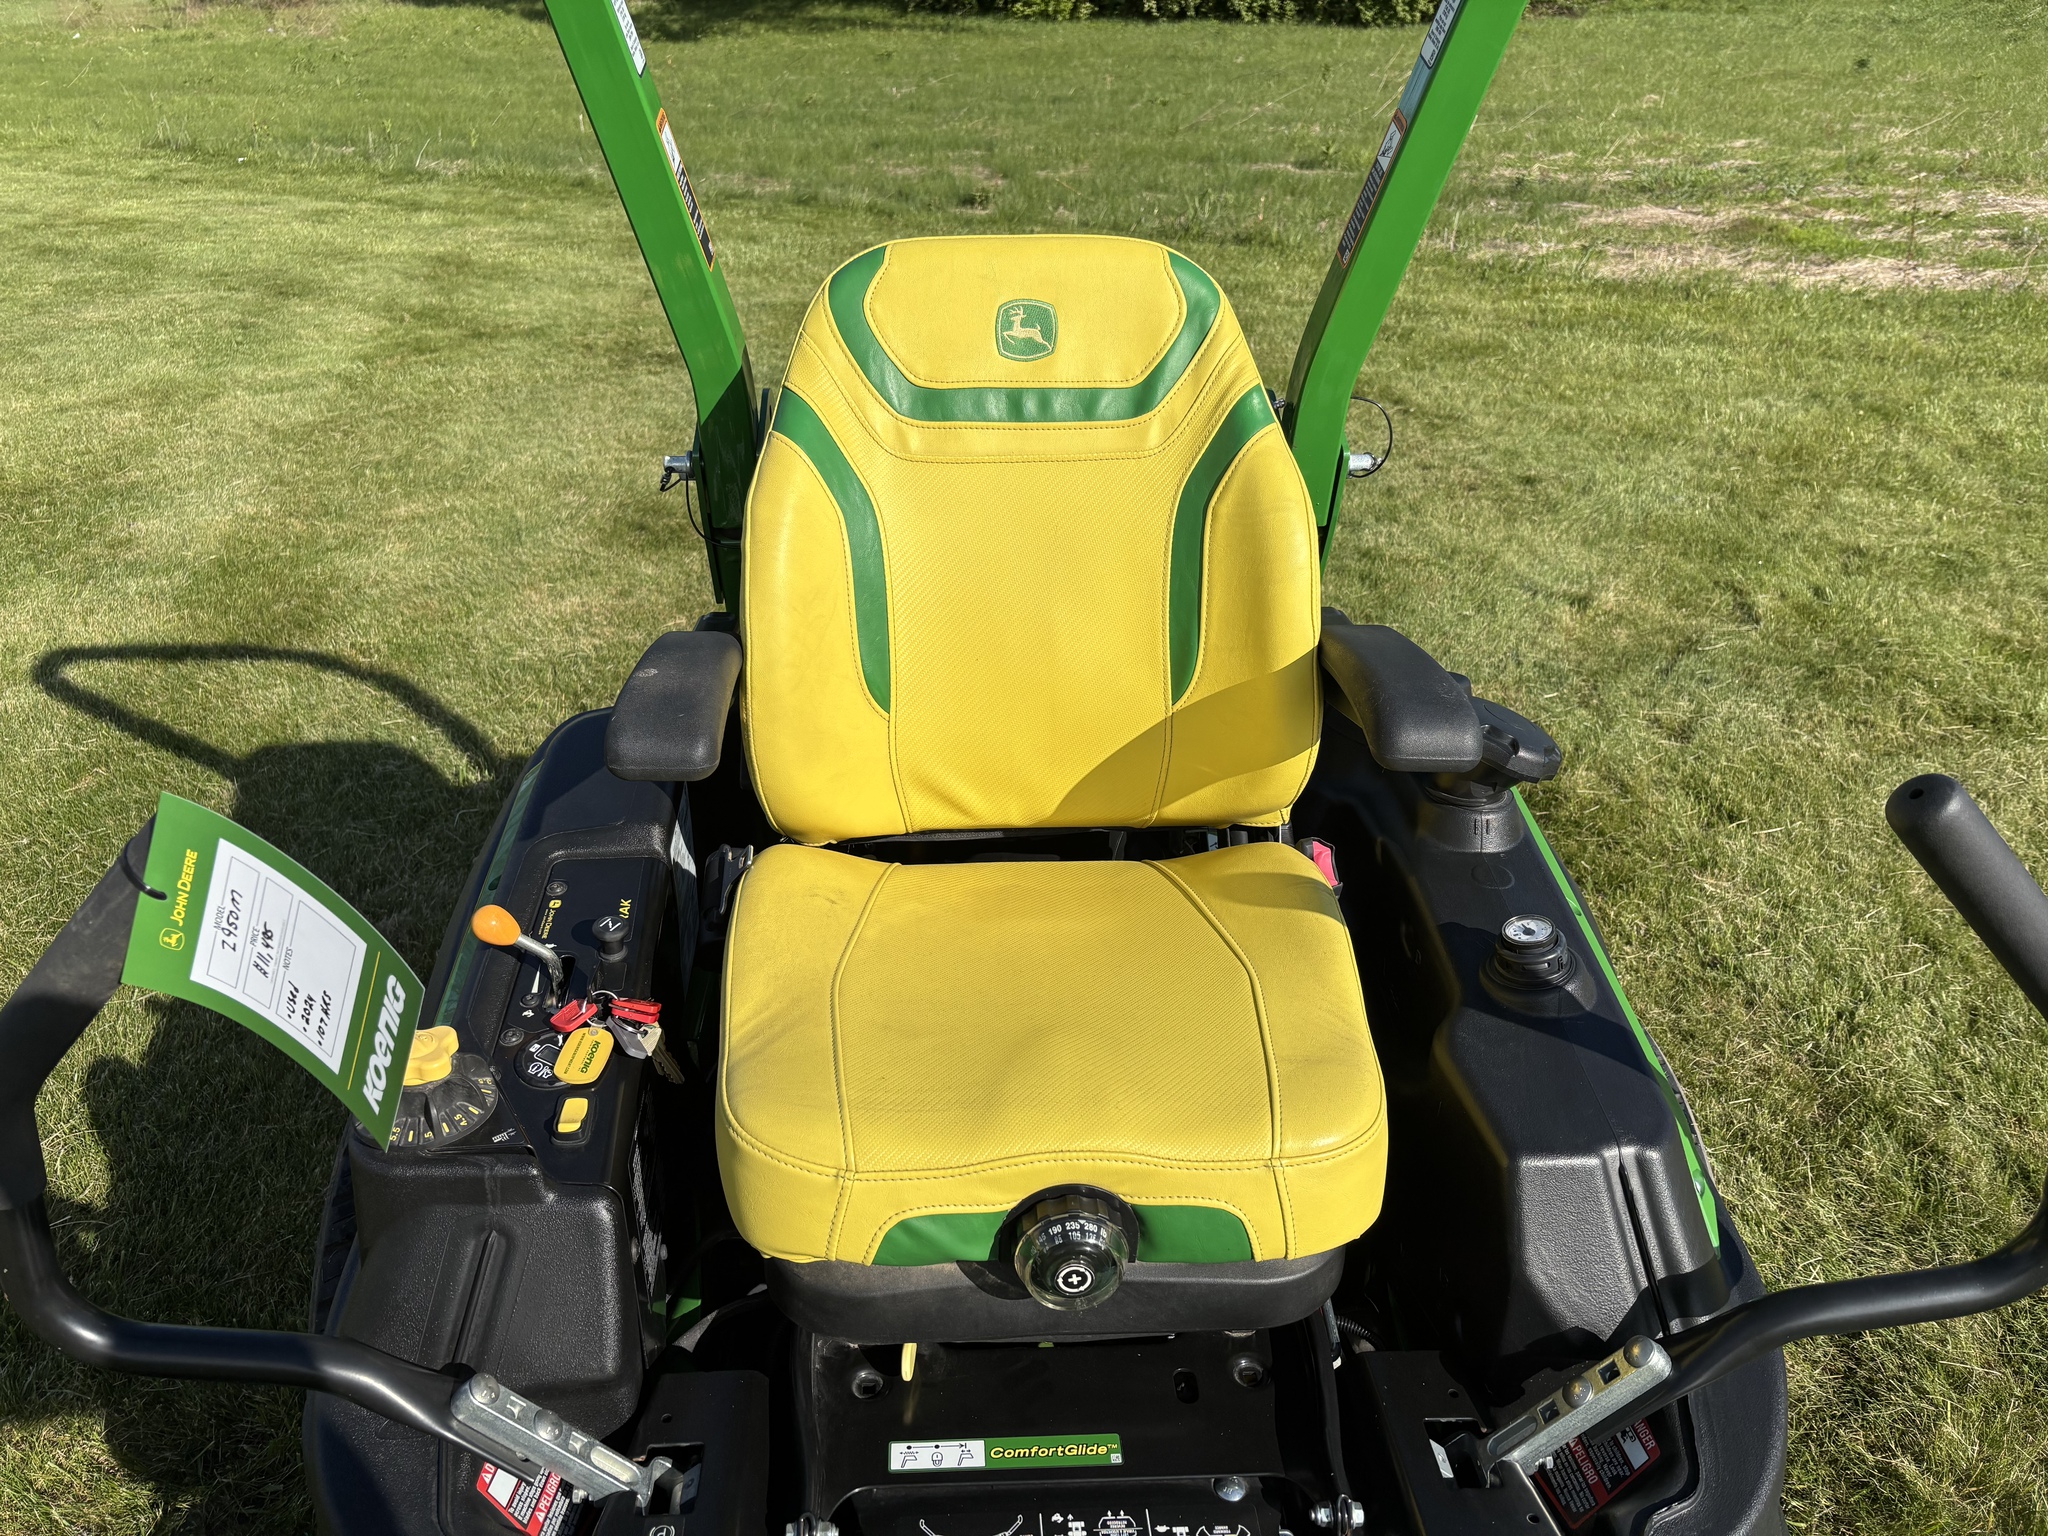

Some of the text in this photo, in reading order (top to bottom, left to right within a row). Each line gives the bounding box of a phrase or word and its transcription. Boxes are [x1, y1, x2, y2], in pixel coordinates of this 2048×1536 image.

[170, 848, 198, 926] JOHN DEERE
[213, 905, 226, 931] MODEL
[250, 926, 260, 948] PRICE
[282, 946, 294, 971] NOTES
[300, 994, 316, 1026] 2024
[316, 1016, 328, 1040] 107
[454, 1114, 468, 1126] 4.5
[390, 1127, 400, 1142] 5.5
[1048, 1224, 1062, 1236] 190
[1065, 1222, 1080, 1230] 235
[1084, 1222, 1098, 1232] 280
[1100, 1228, 1108, 1238] lb
[1068, 1231, 1081, 1241] 105
[1634, 1419, 1655, 1450] ANGER
[1572, 1445, 1598, 1484] PELIGRO
